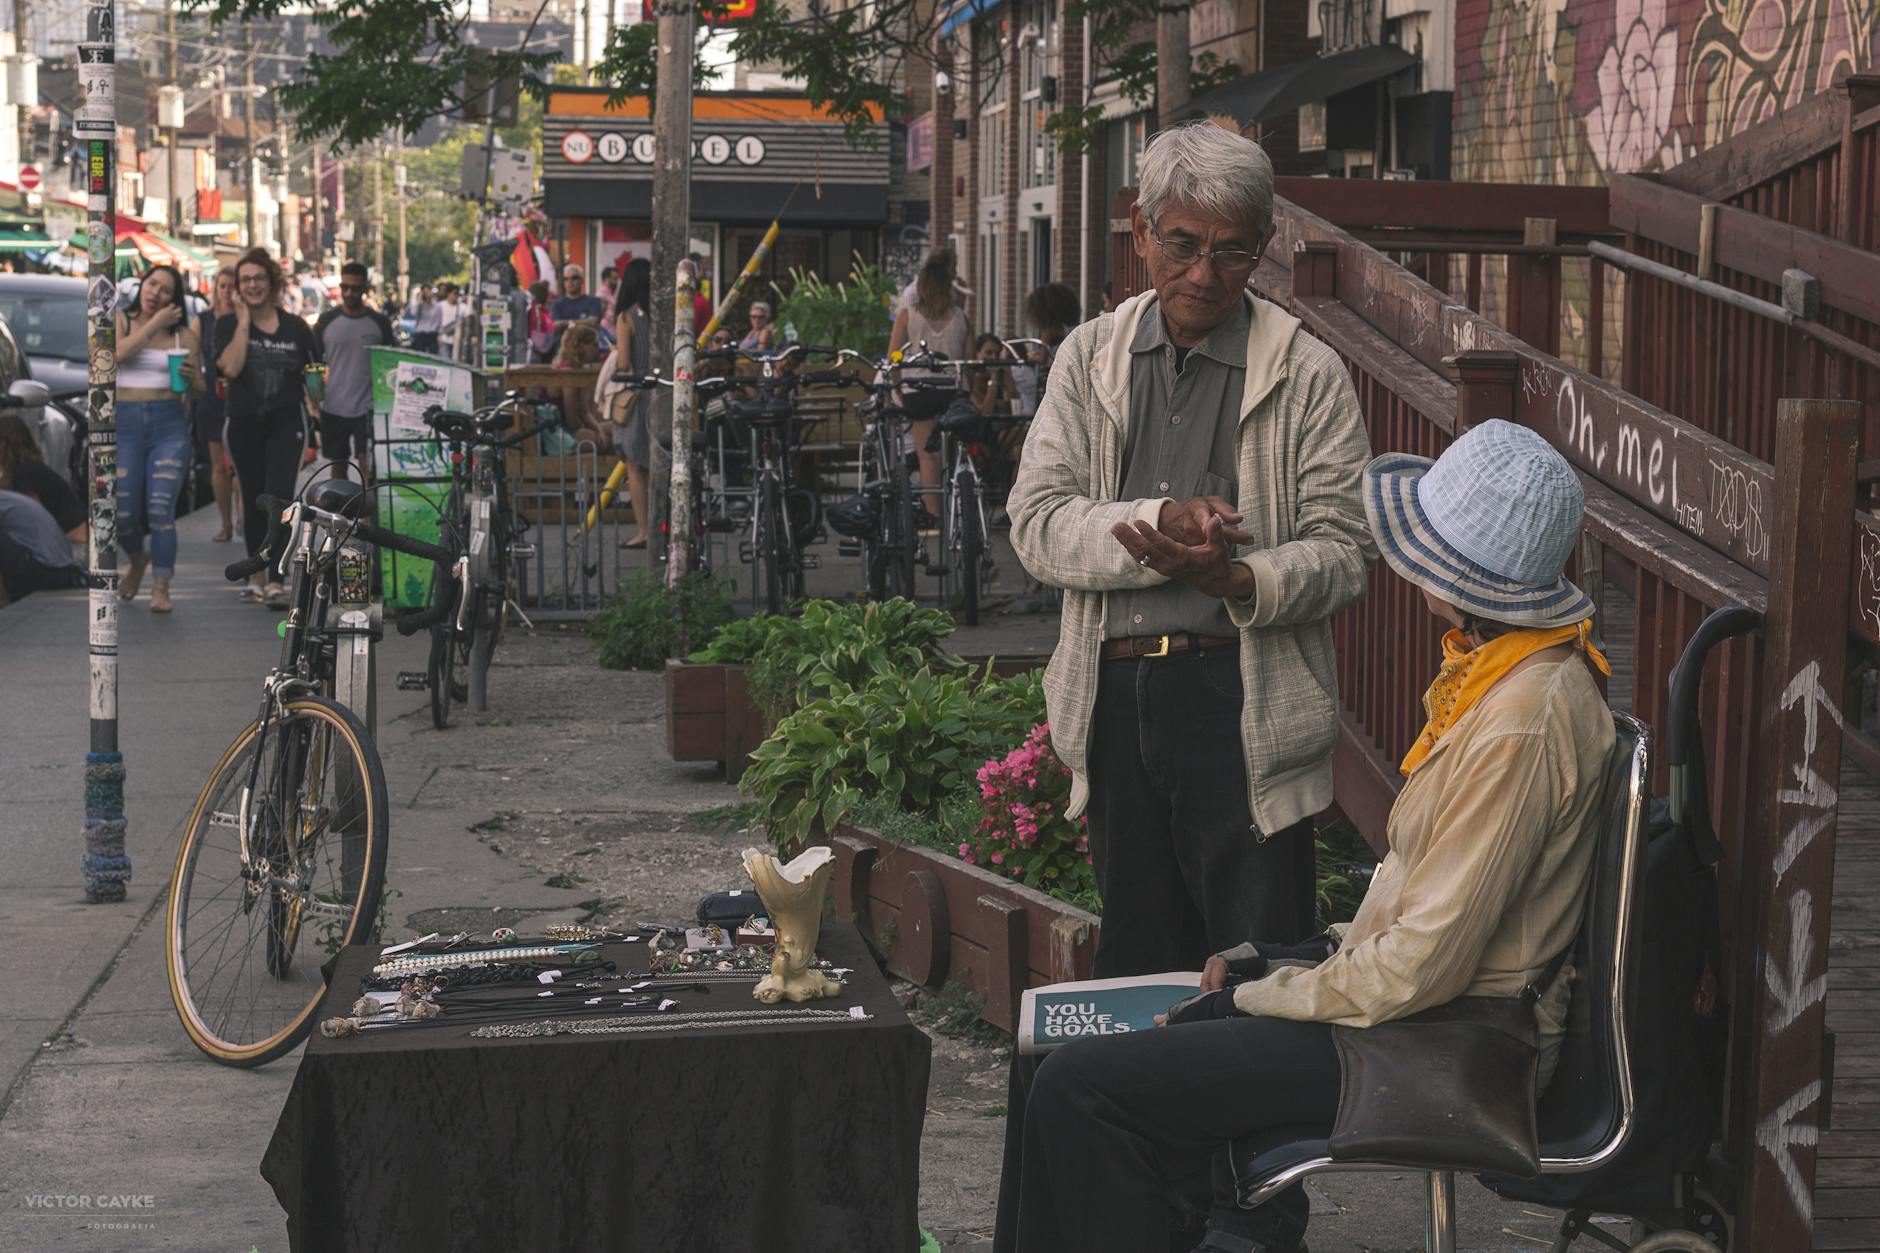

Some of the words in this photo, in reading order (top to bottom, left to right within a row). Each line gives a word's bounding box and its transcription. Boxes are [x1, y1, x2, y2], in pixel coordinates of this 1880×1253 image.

[566, 142, 589, 153] NU
[1044, 1003, 1095, 1016] YOU
[1045, 1013, 1113, 1025] HAVE
[1044, 1022, 1137, 1037] GOALS.
